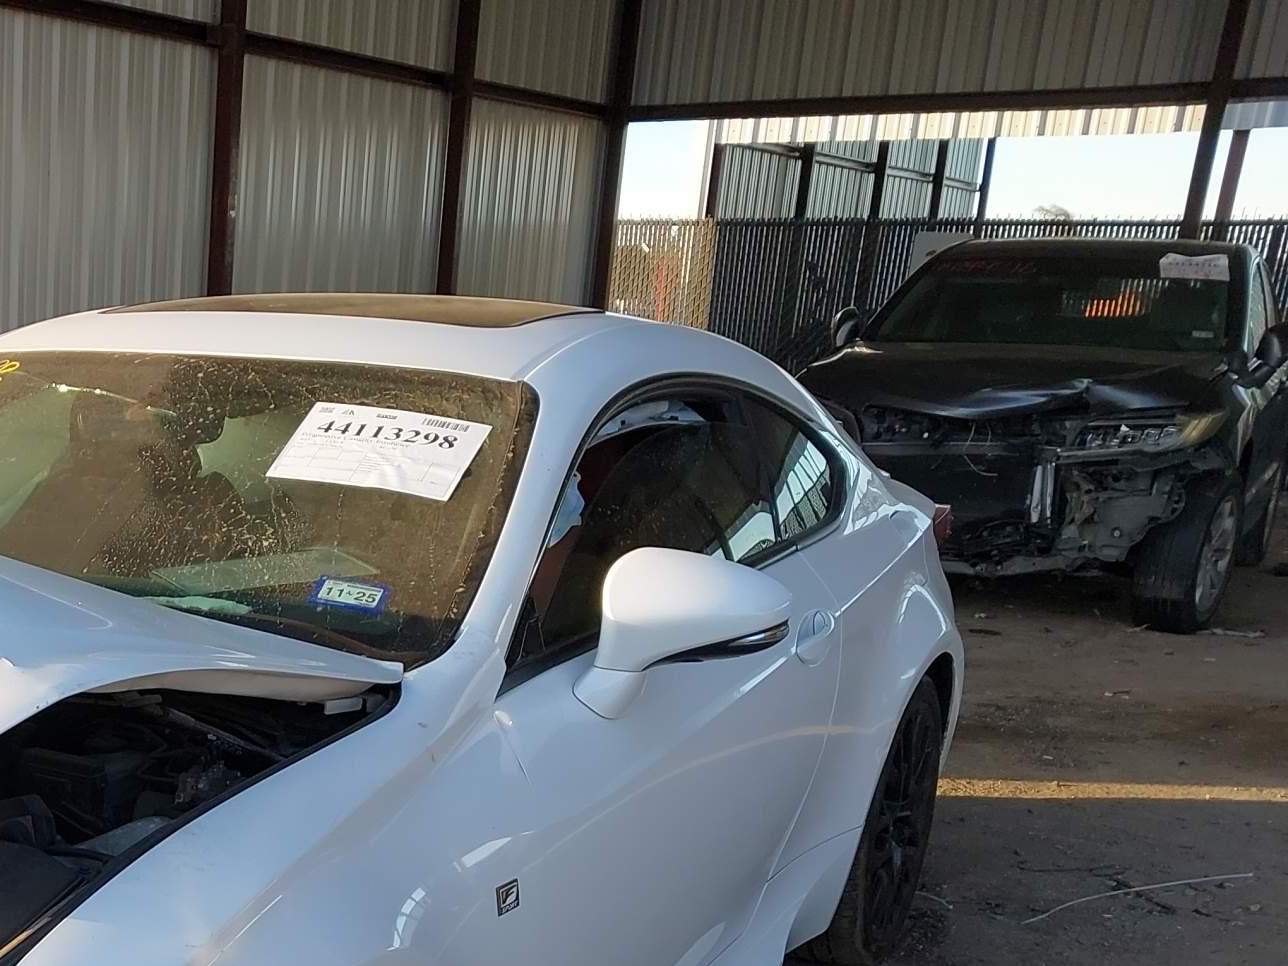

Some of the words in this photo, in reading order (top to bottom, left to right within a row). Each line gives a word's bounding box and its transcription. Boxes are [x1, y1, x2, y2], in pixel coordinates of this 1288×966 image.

[316, 420, 459, 449] 44113298
[326, 586, 345, 598] 11
[353, 590, 378, 604] 25
